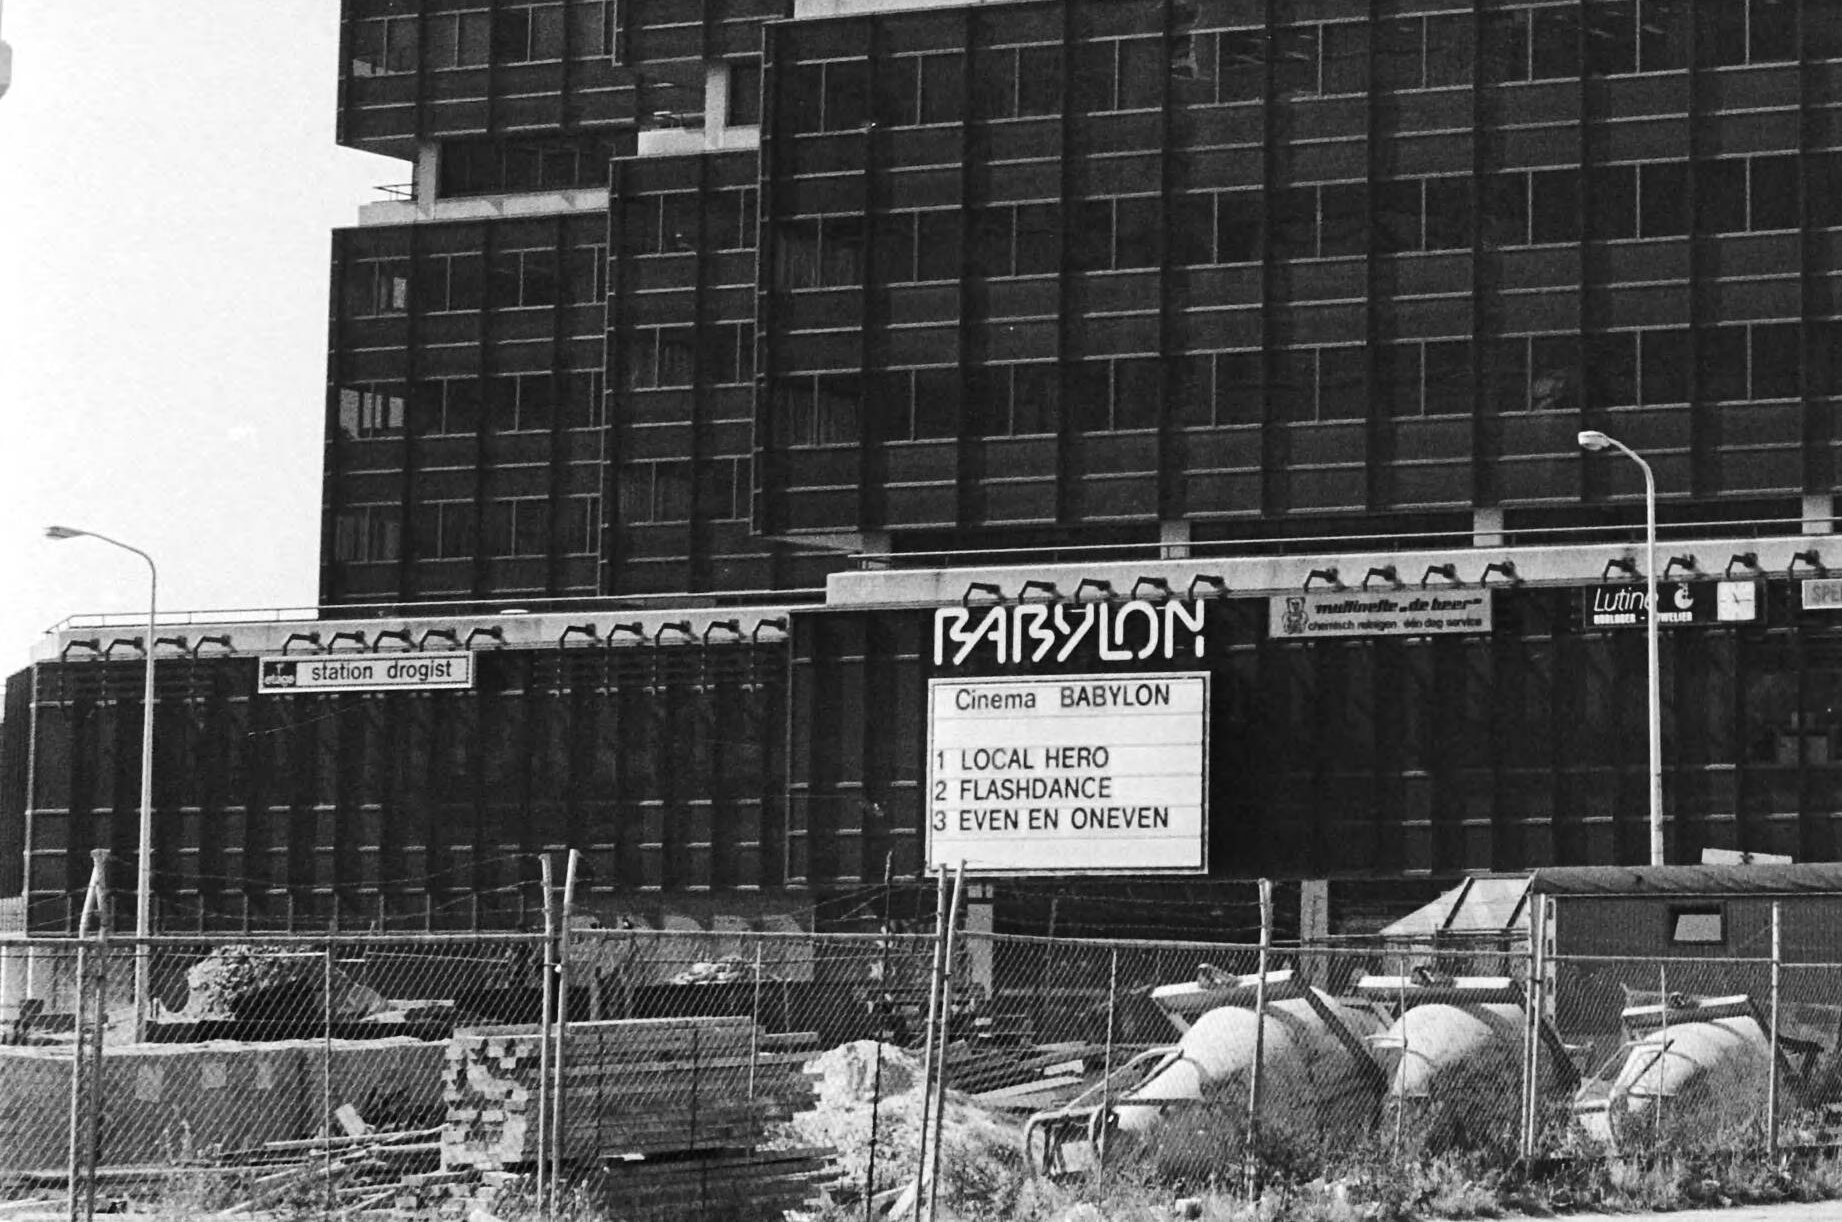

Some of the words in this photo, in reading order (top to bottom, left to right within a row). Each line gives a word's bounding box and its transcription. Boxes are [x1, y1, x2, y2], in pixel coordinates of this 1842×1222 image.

[934, 599, 1204, 665] BABYLON
[312, 661, 373, 681] station
[387, 659, 452, 682] drogist
[955, 688, 1036, 710] Cinema
[1060, 684, 1170, 708] BABYLON
[936, 752, 944, 770] 1
[961, 748, 1034, 770] LOCAL
[1045, 746, 1109, 769] HERO
[935, 781, 948, 801] 2
[960, 777, 1112, 800] FLASHDANCE
[934, 812, 947, 831] 3
[959, 810, 1018, 831] EVEN
[1029, 809, 1059, 830] EN
[1071, 807, 1168, 829] ONEVEN
